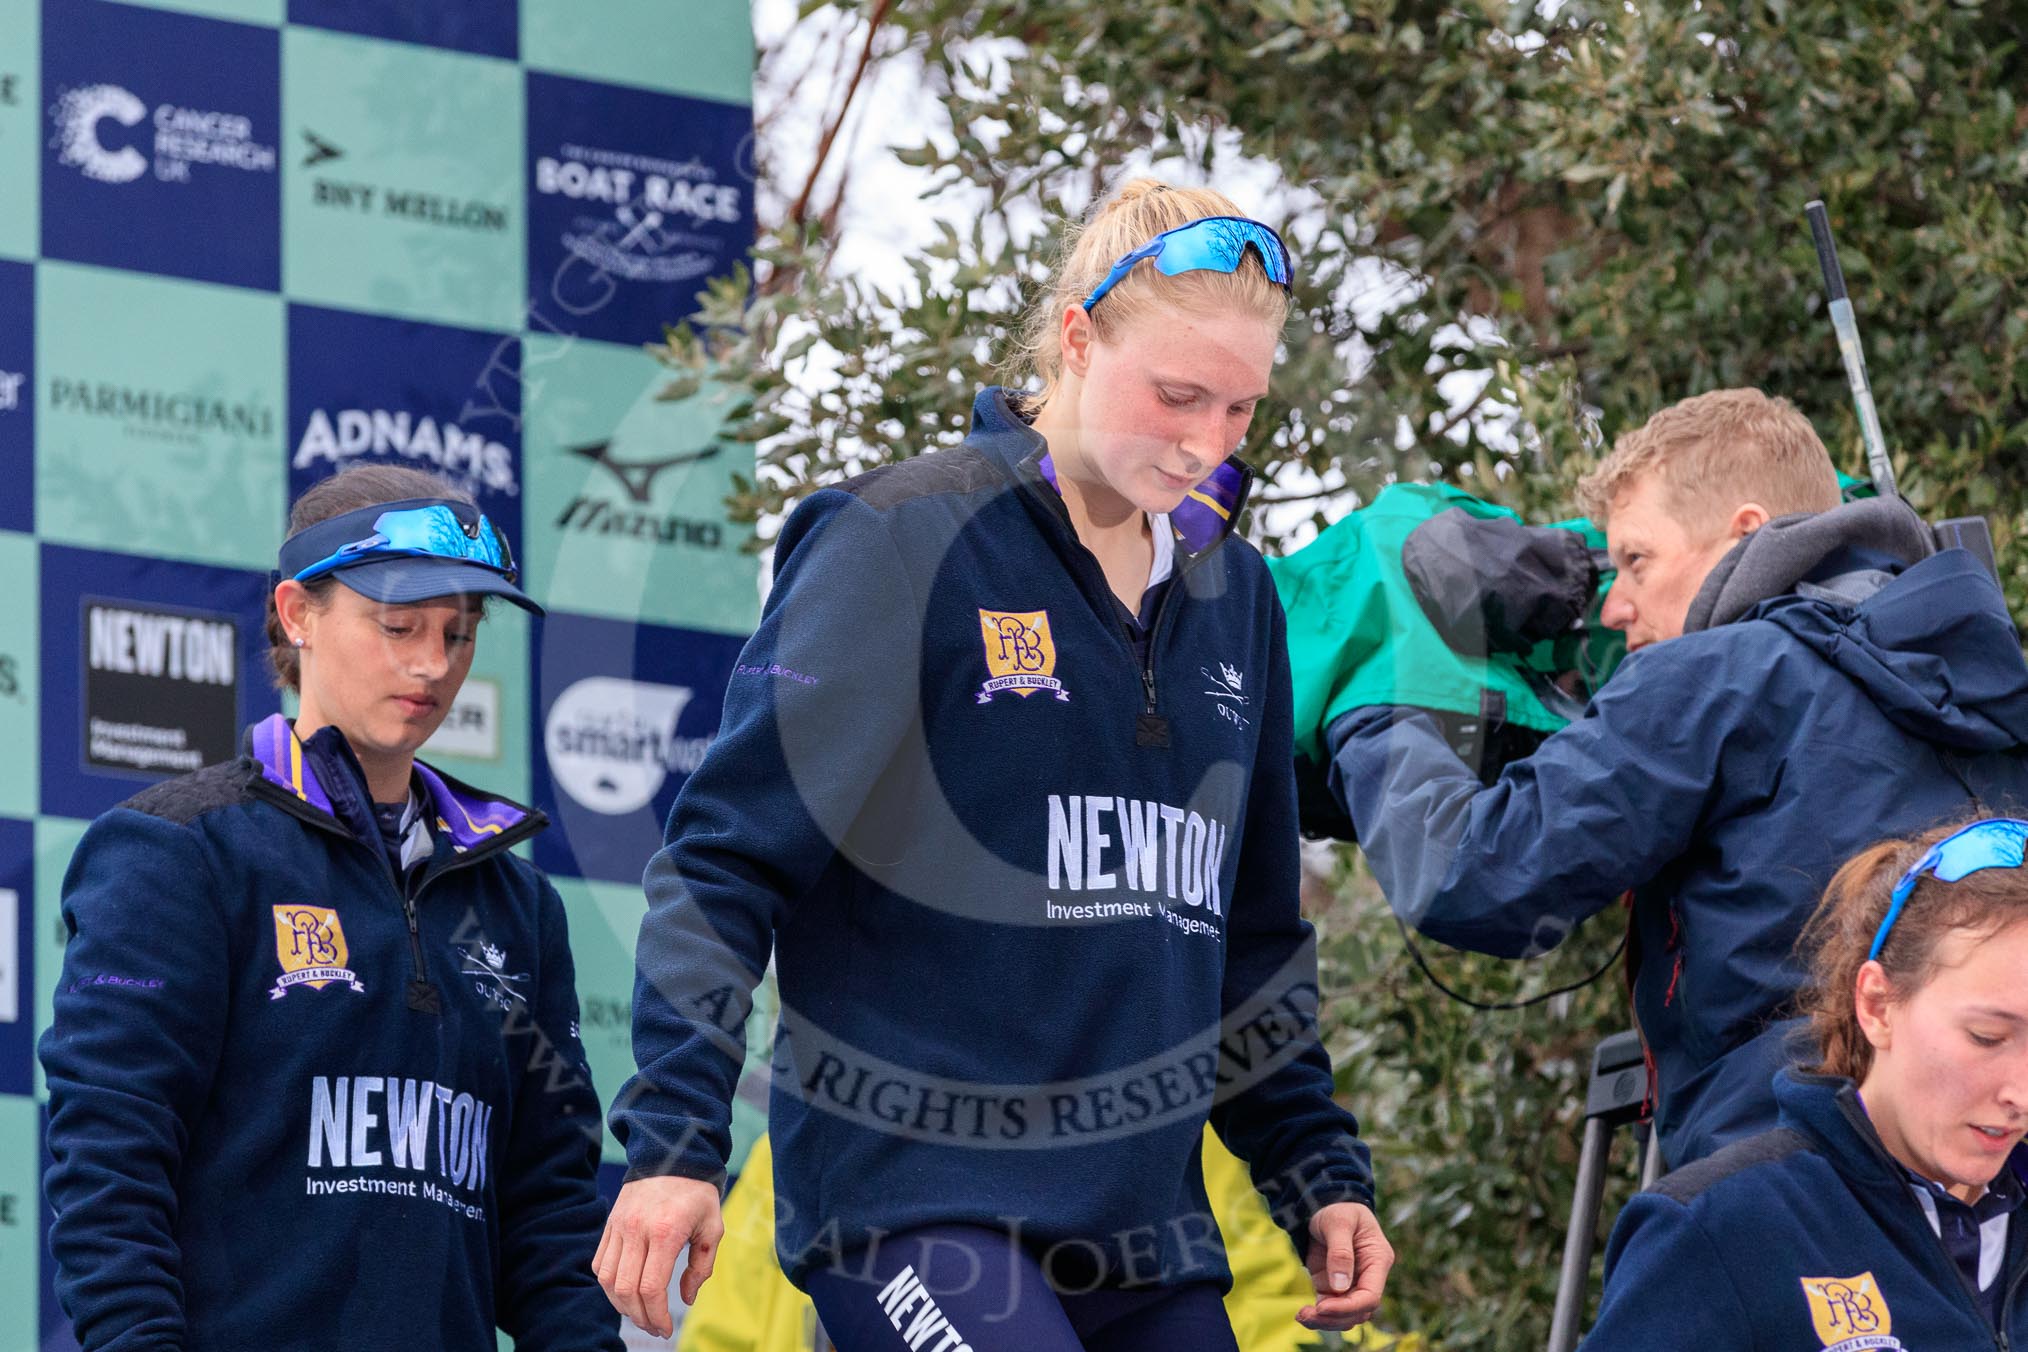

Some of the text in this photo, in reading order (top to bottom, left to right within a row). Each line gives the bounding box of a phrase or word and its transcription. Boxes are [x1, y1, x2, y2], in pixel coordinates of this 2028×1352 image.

[383, 188, 510, 233] MELLON
[536, 156, 636, 203] BOAT
[645, 175, 741, 224] RACE
[50, 375, 275, 438] PARMIGIANI
[292, 408, 514, 491] ADNAMS
[89, 605, 235, 687] NEWTON
[770, 664, 818, 684] BUCKLEY
[988, 676, 1058, 690] RUPERT & BUCKLEY
[90, 717, 187, 751] Investment
[90, 738, 203, 770] Management
[1047, 794, 1226, 917] NEWTON
[1047, 900, 1221, 942] Investment Mangeme
[107, 975, 165, 988] BUCKLEY
[281, 970, 310, 985] RUPERT
[312, 970, 318, 978] &
[307, 1076, 492, 1193] NEWTON
[306, 1176, 486, 1223] Investment Maagen
[877, 1264, 974, 1352] NEWT
